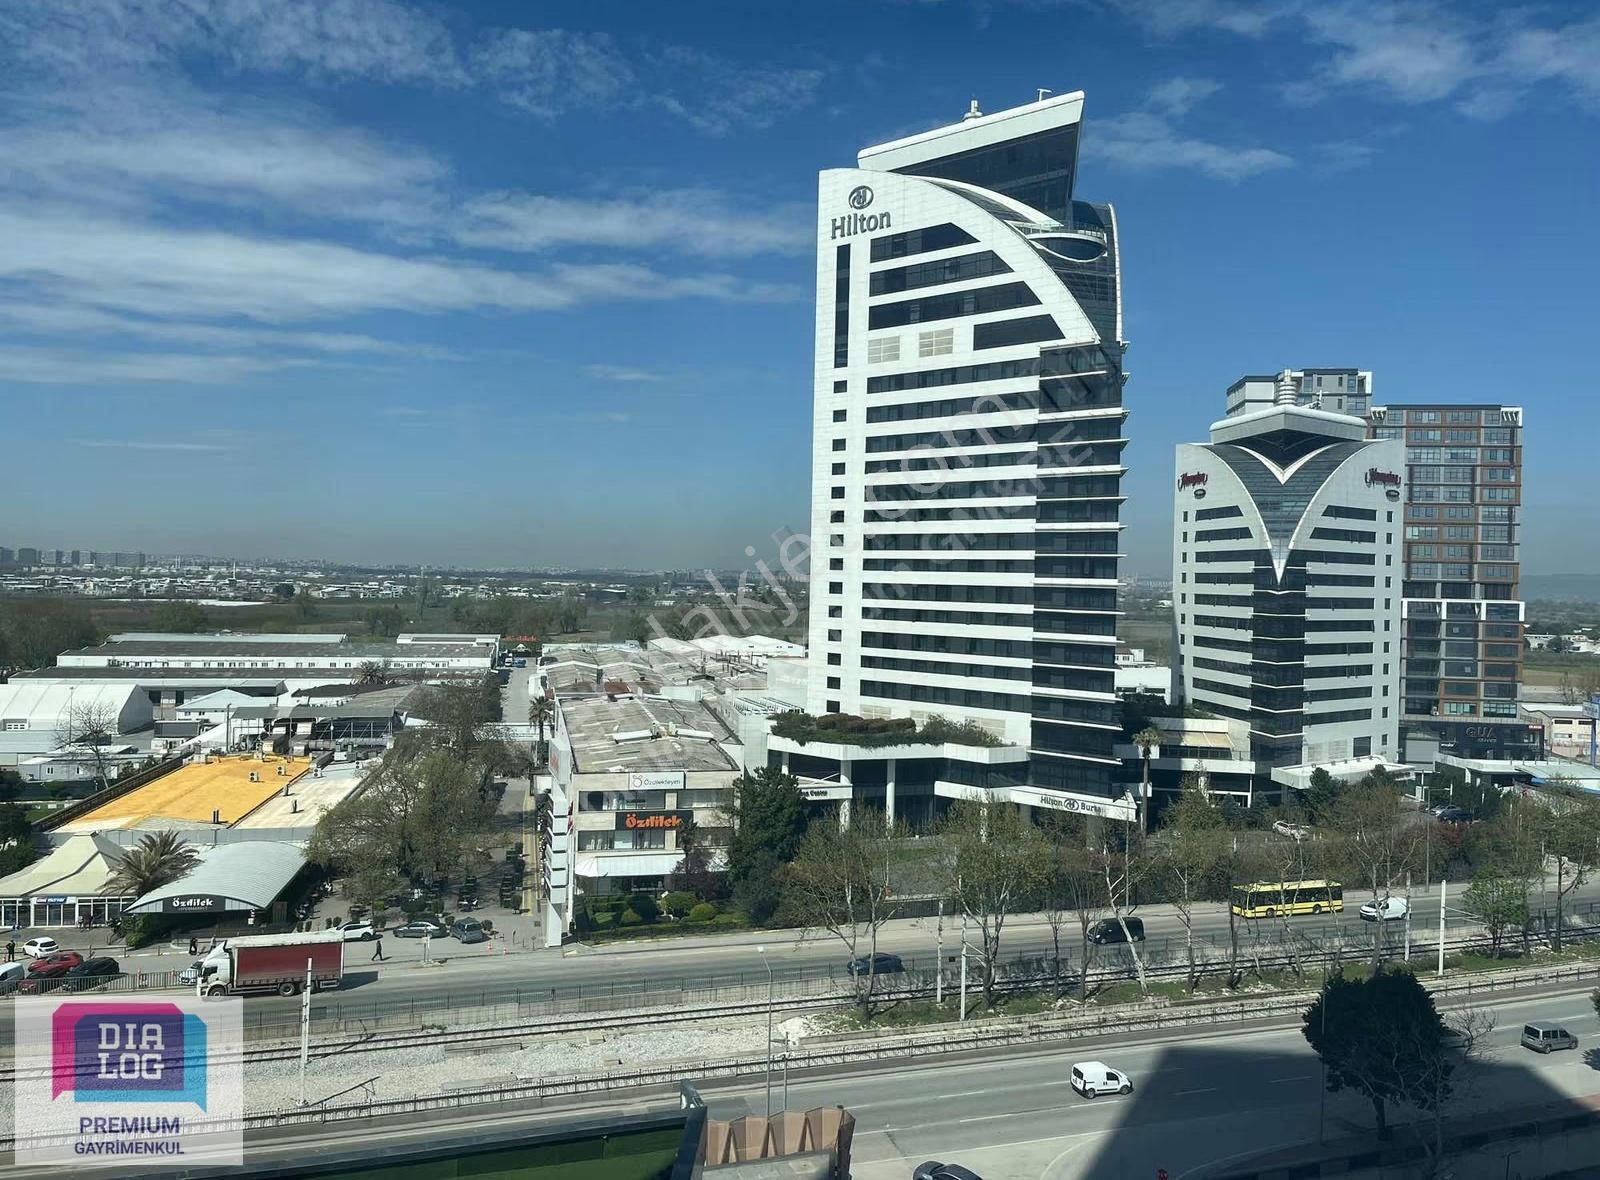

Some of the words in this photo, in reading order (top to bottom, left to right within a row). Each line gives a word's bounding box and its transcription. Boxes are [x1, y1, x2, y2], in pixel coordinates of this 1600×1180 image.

[831, 212, 891, 240] Hilton
[625, 813, 682, 828] Özdilek
[172, 897, 213, 907] Özdilek
